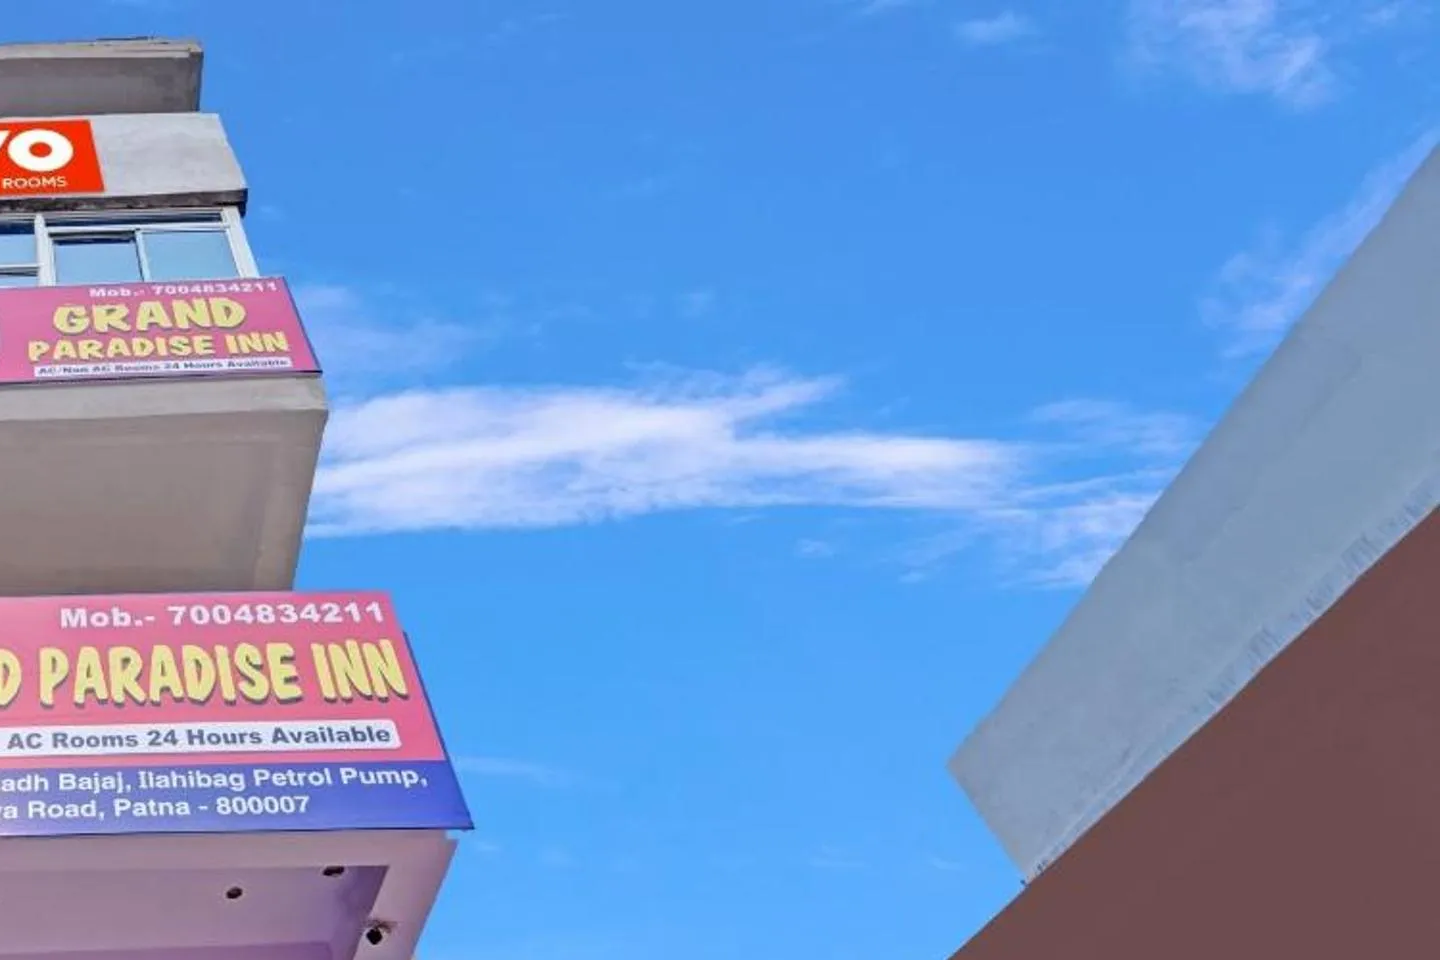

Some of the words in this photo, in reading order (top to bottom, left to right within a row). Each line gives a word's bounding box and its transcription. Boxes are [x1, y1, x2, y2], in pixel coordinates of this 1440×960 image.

[1, 176, 68, 189] ROOMS
[52, 297, 247, 334] GRAND
[28, 334, 216, 362] PARADISE
[224, 331, 290, 355] INN
[60, 606, 156, 629] Mob.-
[167, 601, 385, 626] 7004834211
[39, 642, 304, 706] PARADISE
[309, 639, 411, 701] INN
[7, 733, 43, 750] AC
[51, 731, 139, 749] Rooms
[146, 729, 179, 747] 24
[186, 728, 263, 746] Hours
[271, 725, 391, 745] Available
[59, 772, 131, 795] Bajaj,
[138, 769, 246, 793] Ilahibag
[253, 768, 332, 788] Petrol
[340, 767, 427, 789] Pump,
[28, 800, 105, 822] Road,
[113, 798, 192, 818] Patna
[216, 795, 310, 816] 800007
